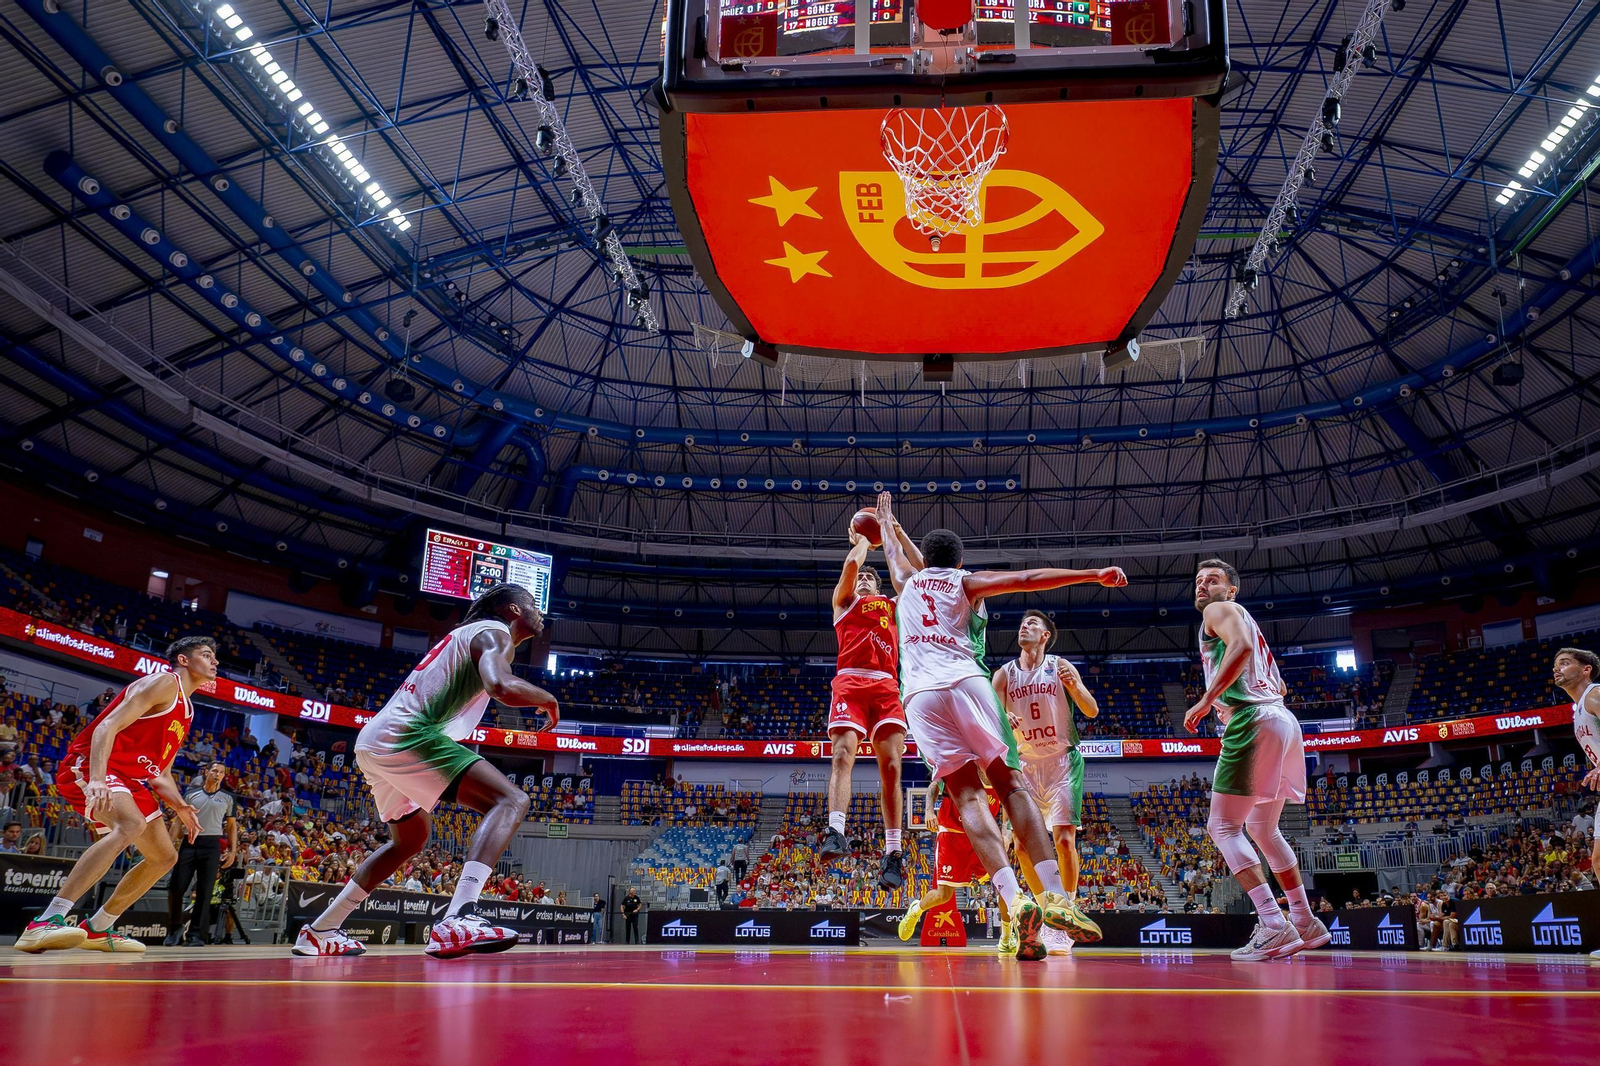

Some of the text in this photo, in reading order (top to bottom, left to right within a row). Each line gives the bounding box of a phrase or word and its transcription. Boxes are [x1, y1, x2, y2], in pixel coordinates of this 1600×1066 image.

[856, 183, 884, 223] FEB
[477, 542, 485, 551] 9
[495, 546, 507, 556] 20
[480, 566, 502, 578] 2:00
[912, 579, 954, 594] MNTEIRO
[921, 593, 939, 628] 3
[879, 616, 889, 629] 5
[25, 624, 114, 659] #alimentosdespaña
[234, 686, 275, 708] Wilson
[1009, 682, 1057, 702] PORTUGAL
[300, 700, 331, 720] SDI
[1030, 701, 1041, 720] 6
[1496, 714, 1544, 730] Wilson
[1022, 725, 1057, 741] una
[1383, 728, 1418, 743] AVIS
[556, 736, 597, 750] Wilson
[622, 738, 650, 753] SDI
[673, 743, 745, 753] #alimentosdespaña
[763, 743, 794, 755] AVIS
[1079, 745, 1116, 753] RTUGAL
[1161, 742, 1203, 753] Wilson
[5, 868, 68, 888] tenerife
[117, 923, 168, 937] aFamilia
[661, 928, 697, 937] LOTUS
[735, 928, 771, 937] LOTUS
[810, 929, 846, 938] LOTUS
[927, 929, 960, 938] CaixaBank
[1463, 926, 1503, 945] LOTUS
[1531, 925, 1582, 946] LOTUS
[1139, 931, 1192, 944] LOTUS
[1329, 932, 1351, 945] LOTUS
[1377, 931, 1405, 945] LOTUS
